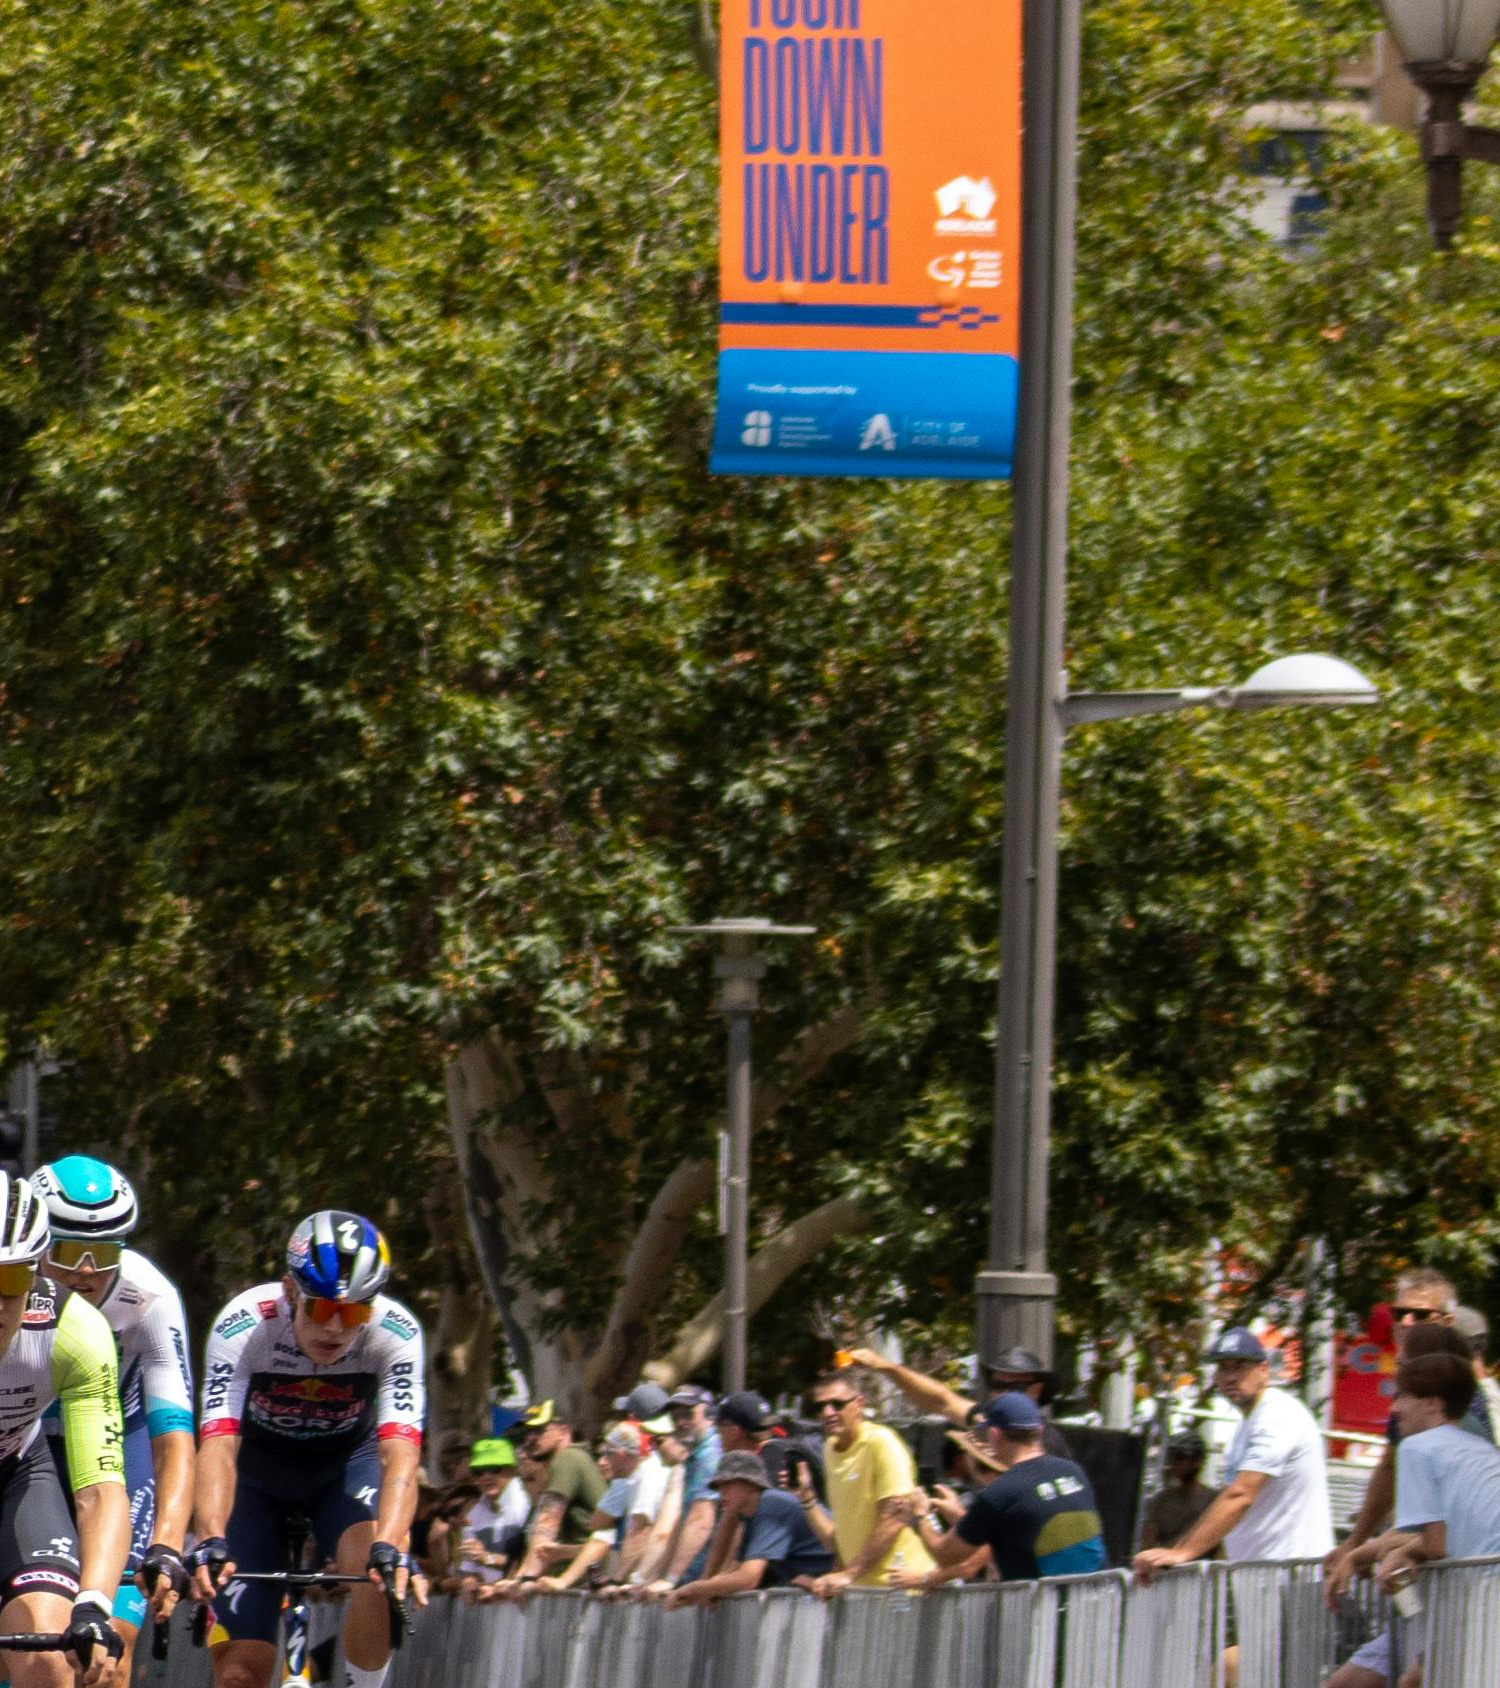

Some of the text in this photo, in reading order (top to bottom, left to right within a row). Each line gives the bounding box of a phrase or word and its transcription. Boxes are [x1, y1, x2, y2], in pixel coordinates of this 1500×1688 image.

[744, 37, 883, 156] DOWN
[744, 164, 889, 284] UNDER
[215, 1308, 251, 1334] BORA
[386, 1309, 419, 1337] BORA
[206, 1362, 234, 1410] BOSS
[392, 1361, 414, 1412] BOSS
